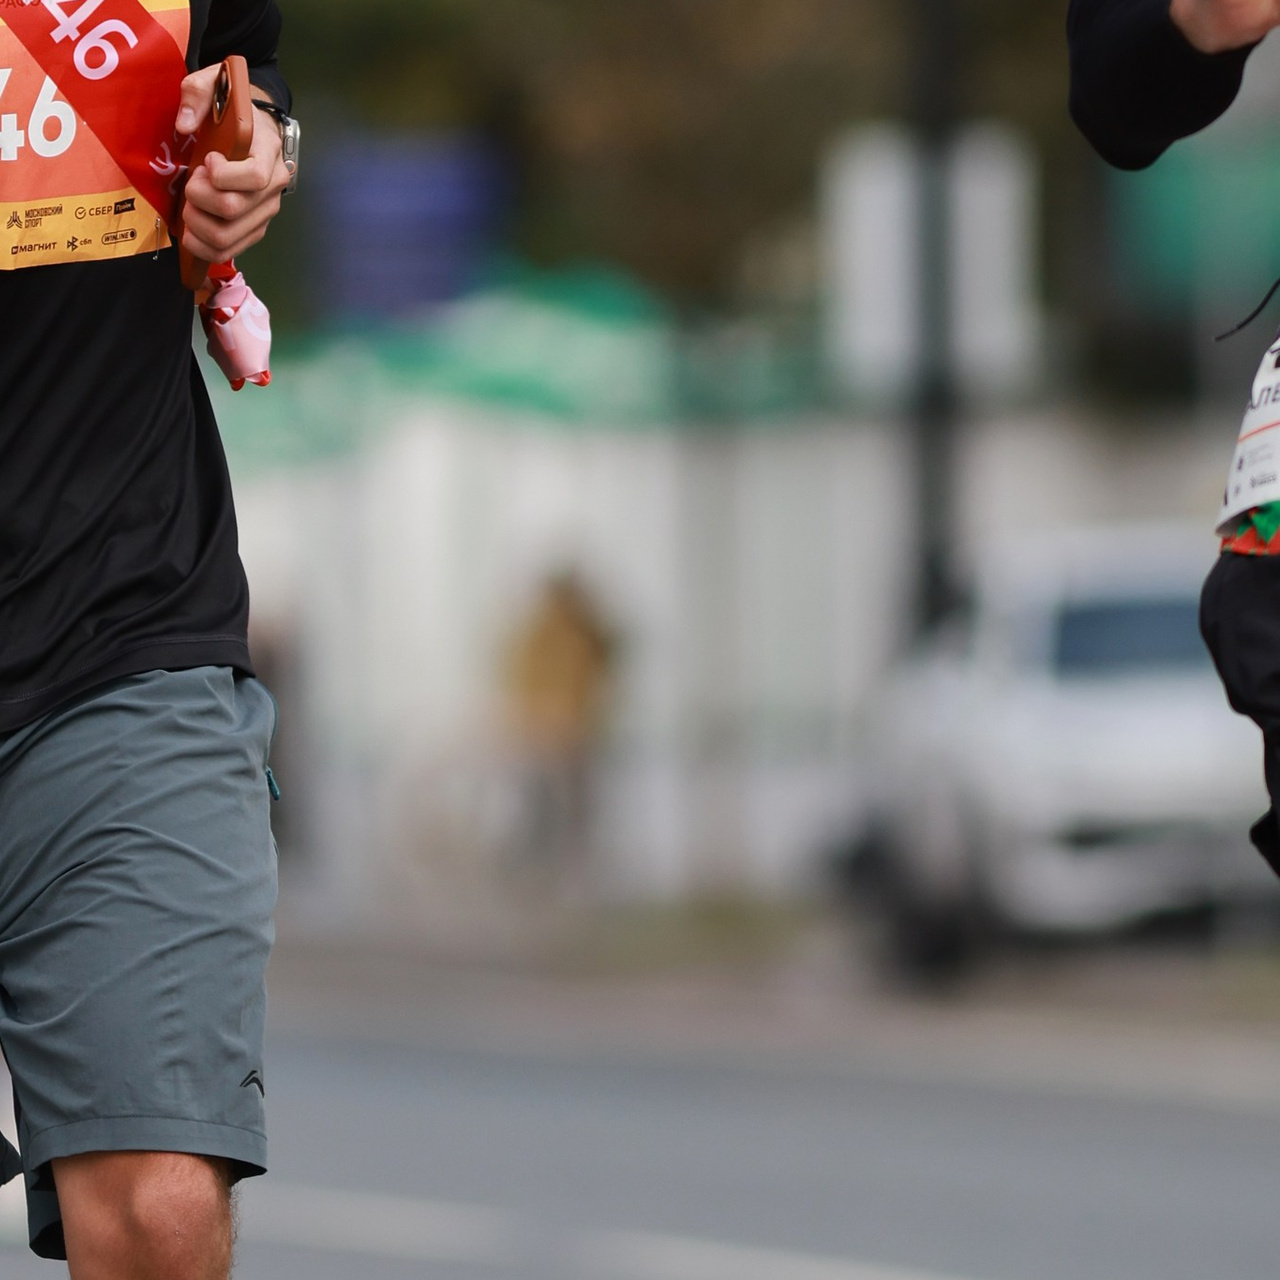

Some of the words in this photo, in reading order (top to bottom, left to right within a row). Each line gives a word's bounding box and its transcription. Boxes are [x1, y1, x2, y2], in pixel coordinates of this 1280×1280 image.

[24, 203, 64, 219] МОСКОВСКИЙ
[88, 205, 113, 217] СБЕР
[24, 217, 43, 229] СПОРТ
[79, 238, 93, 246] сбп
[104, 231, 130, 243] WINLINE
[18, 241, 58, 254] магнит
